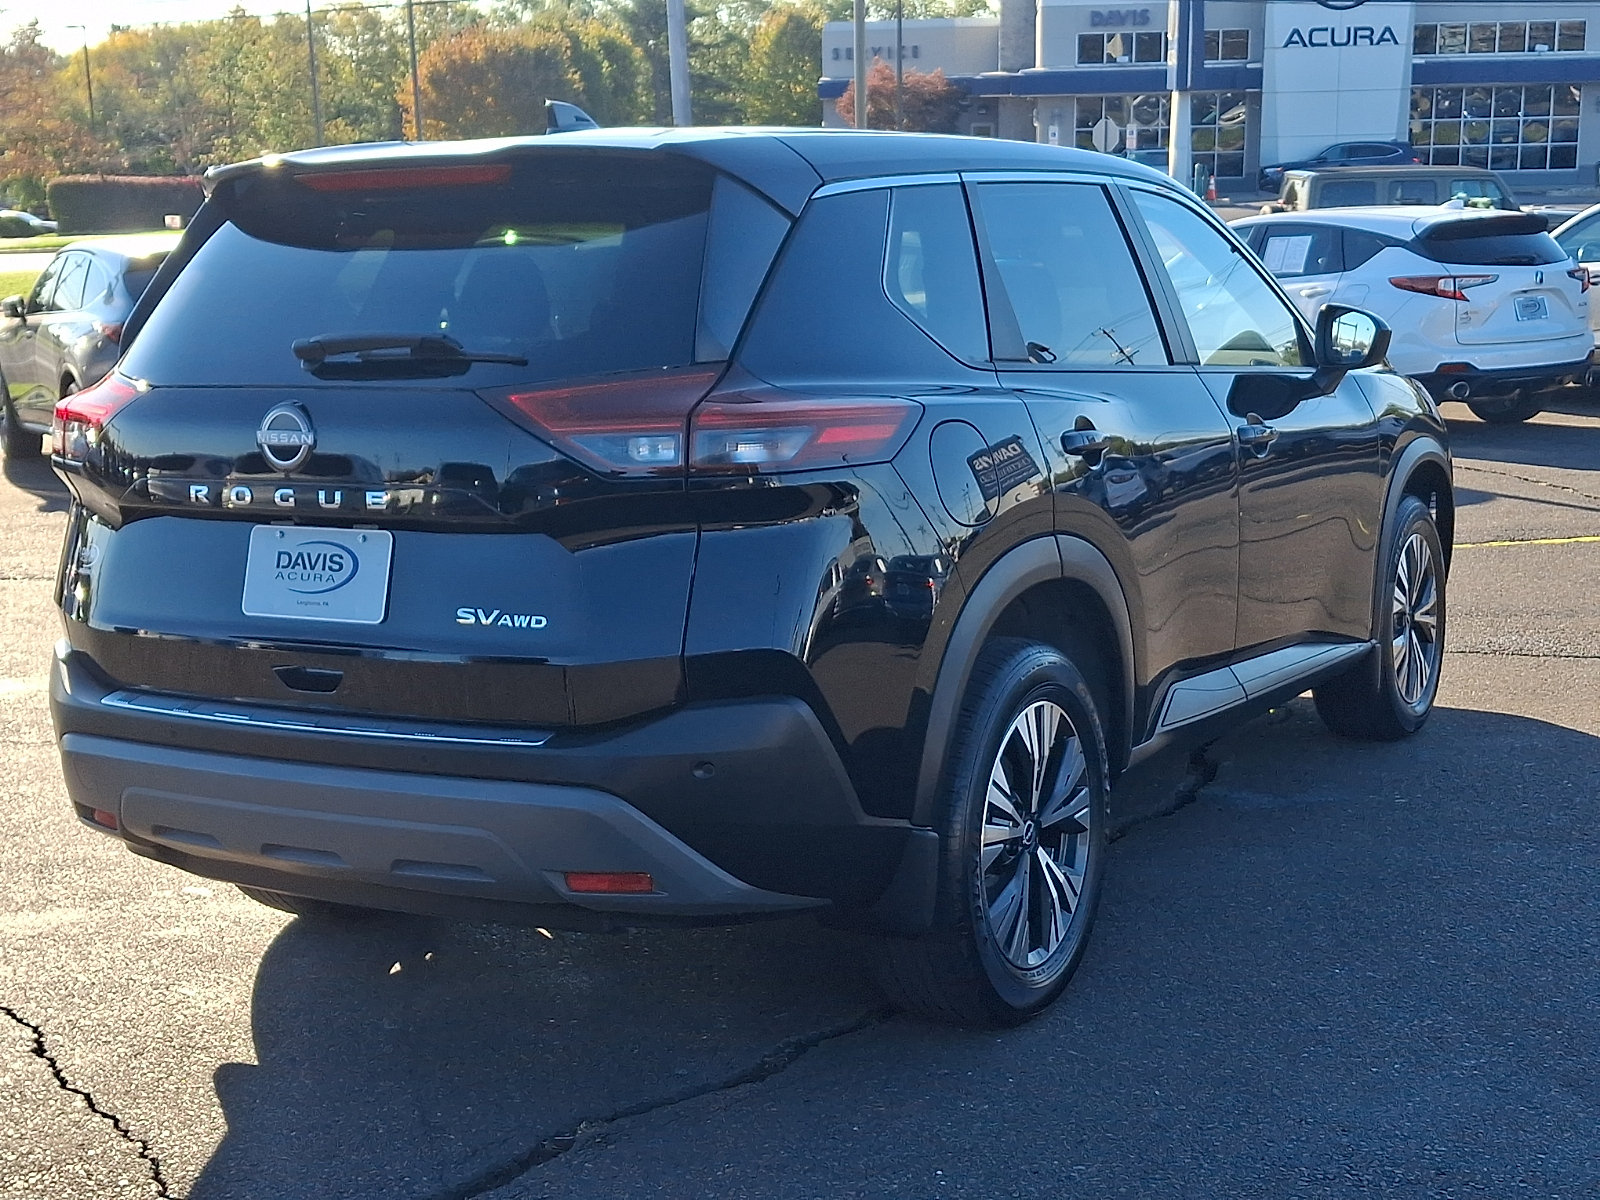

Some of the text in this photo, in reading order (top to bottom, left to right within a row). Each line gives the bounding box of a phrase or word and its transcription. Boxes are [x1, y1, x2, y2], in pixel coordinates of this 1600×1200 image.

[1090, 9, 1151, 27] DAVIS
[1283, 25, 1399, 48] ACURA
[257, 432, 313, 444] NISSAN
[189, 485, 388, 510] ROGUE
[276, 551, 344, 572] DAVIS
[275, 571, 336, 583] ACURA
